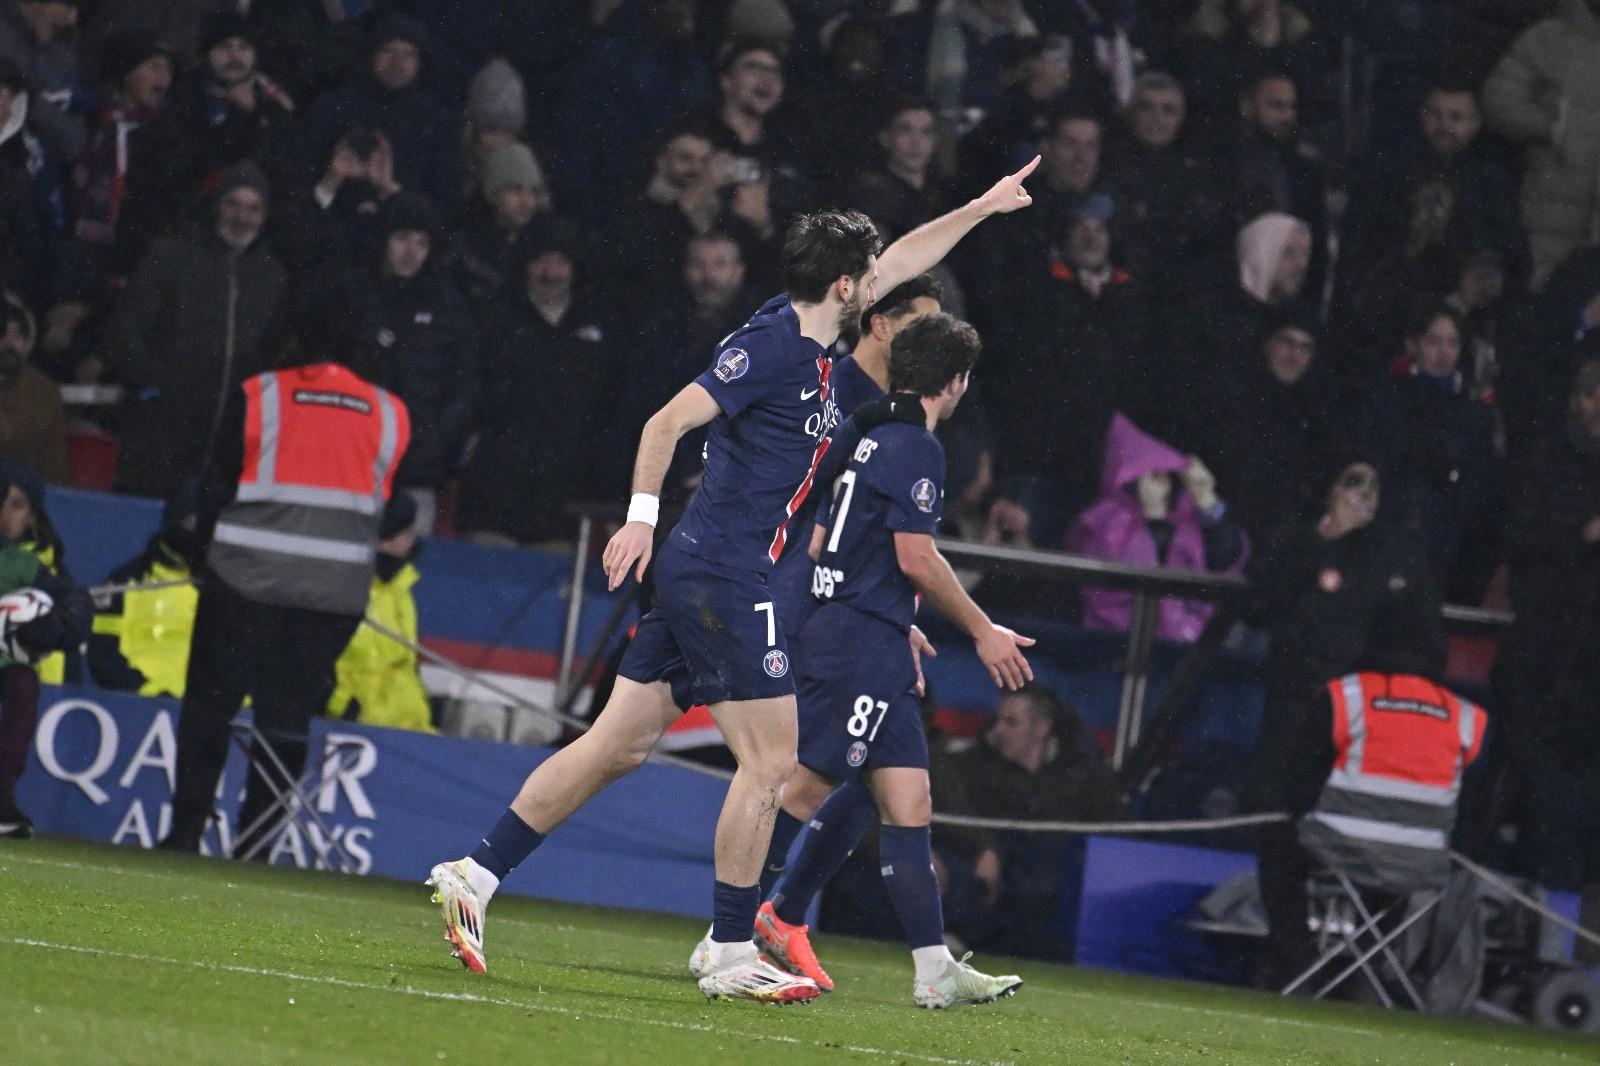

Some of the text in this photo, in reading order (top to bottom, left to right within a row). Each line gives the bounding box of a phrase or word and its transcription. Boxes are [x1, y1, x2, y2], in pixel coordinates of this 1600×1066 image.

[828, 469, 856, 553] 7
[754, 601, 776, 647] 7
[847, 694, 889, 742] 87
[35, 699, 378, 819] QAR
